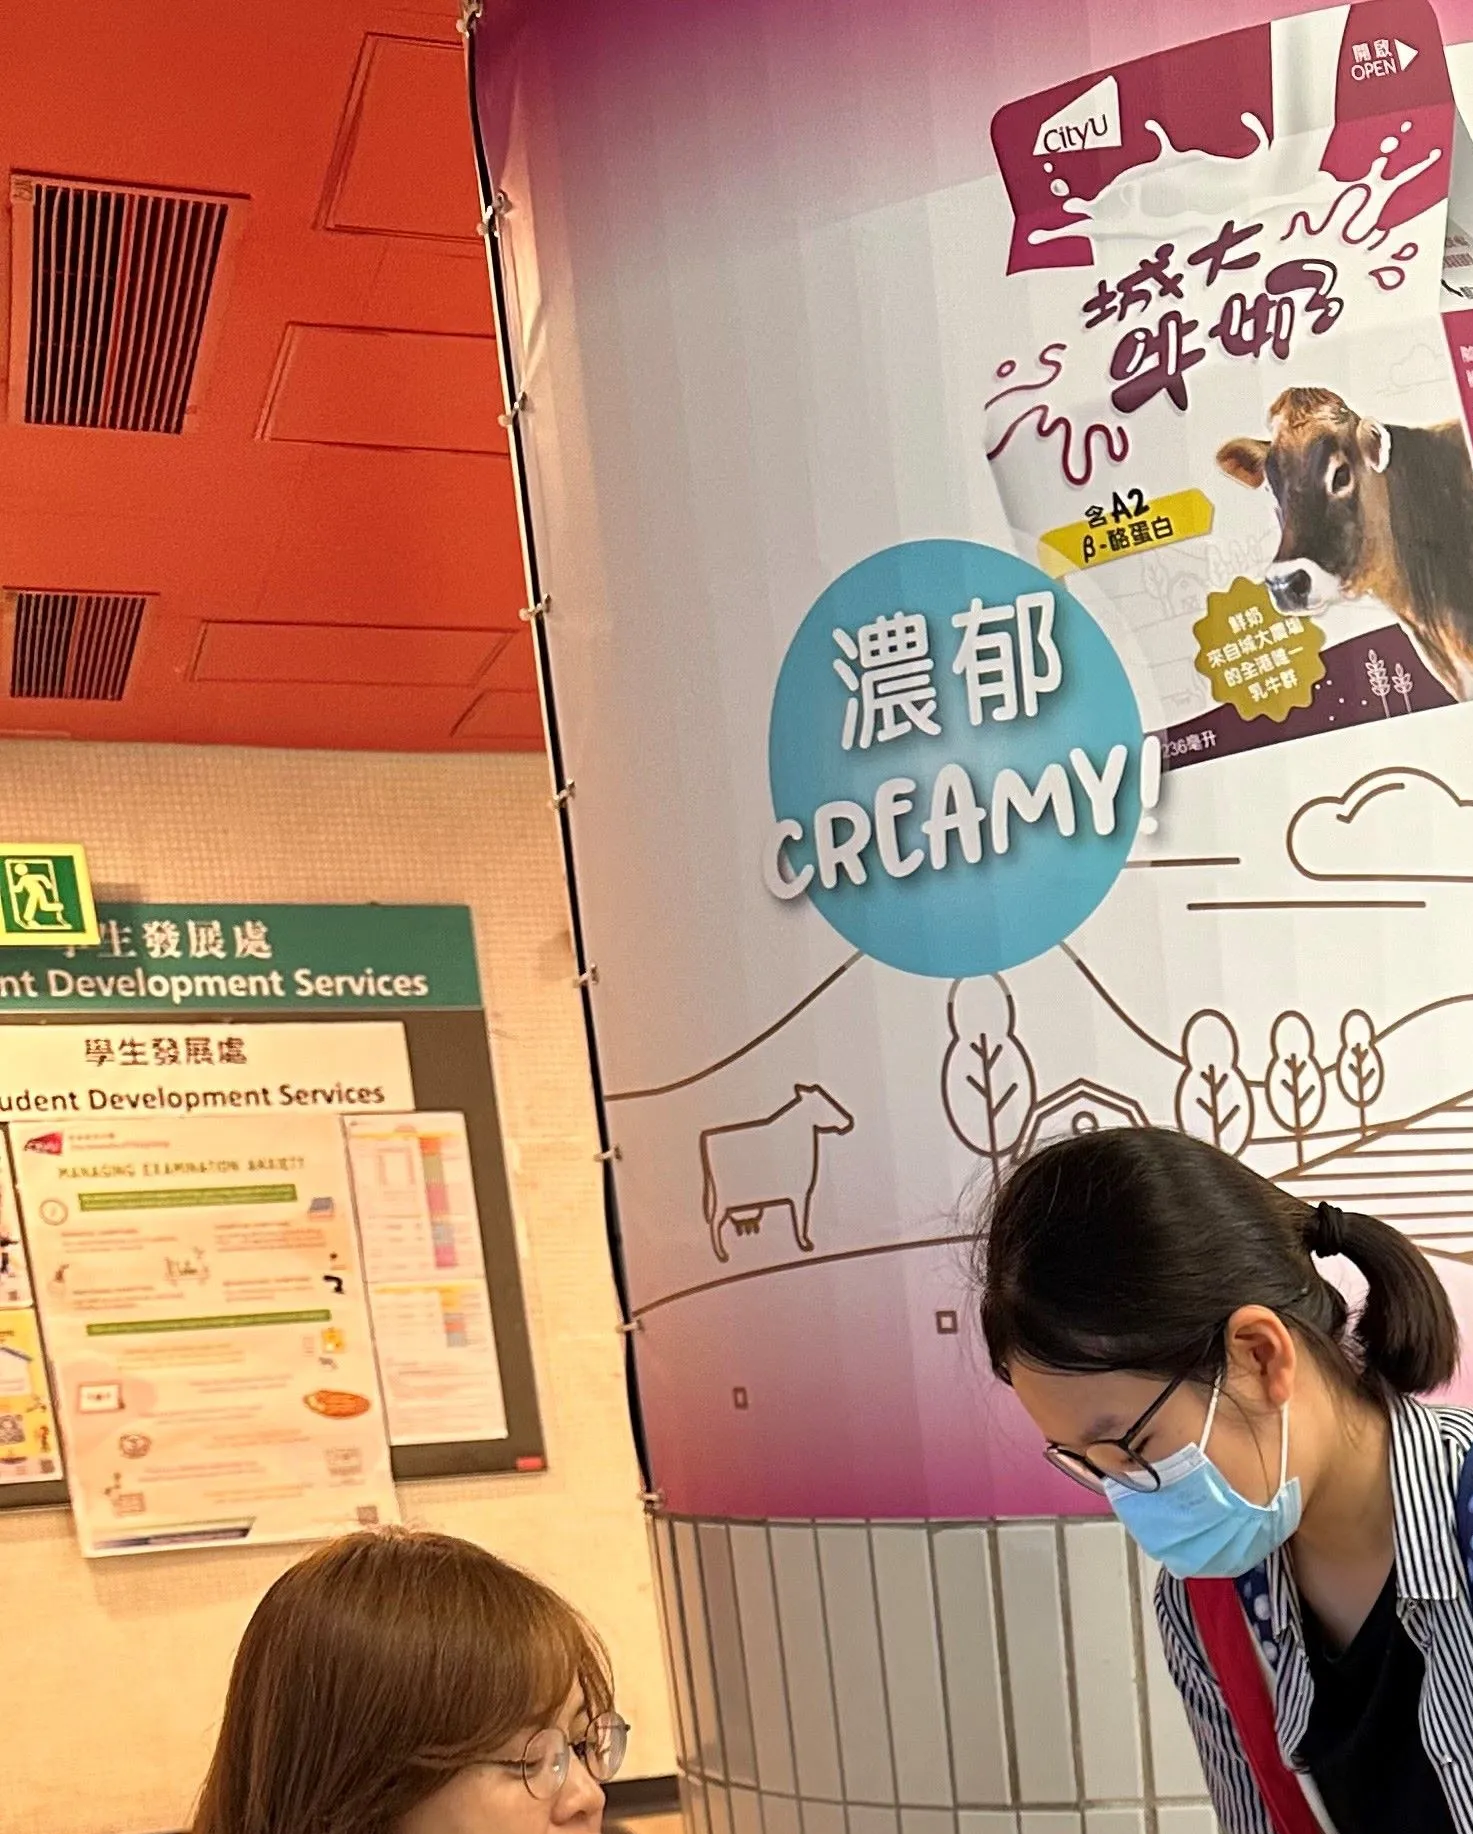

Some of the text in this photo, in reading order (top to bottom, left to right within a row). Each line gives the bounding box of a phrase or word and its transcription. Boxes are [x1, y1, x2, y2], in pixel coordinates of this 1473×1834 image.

[1351, 57, 1397, 82] OPEN
[1043, 112, 1109, 154] CityU
[832, 590, 1063, 750] 濃郁
[763, 735, 1163, 900] CREAMY!
[47, 968, 284, 1004] Development
[295, 969, 428, 998] Services
[89, 1087, 271, 1119] Development
[279, 1084, 385, 1106] Services
